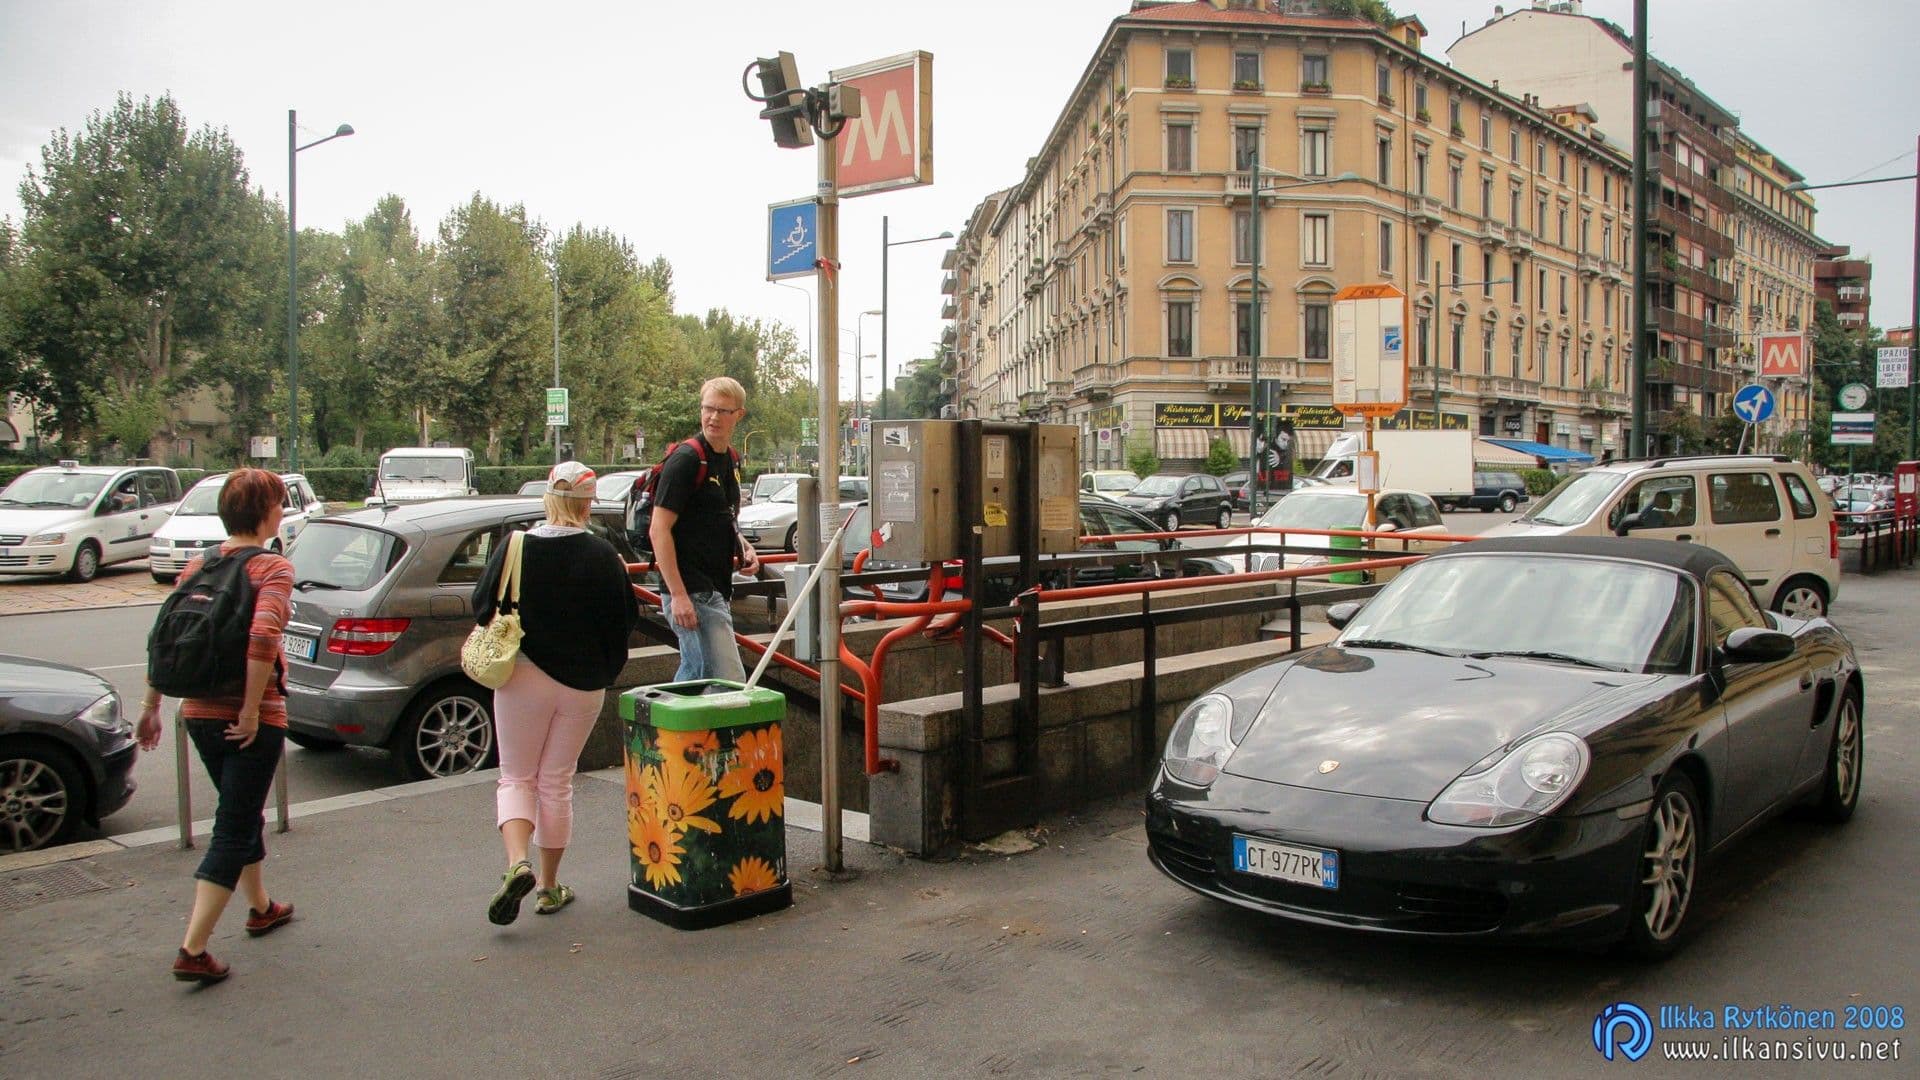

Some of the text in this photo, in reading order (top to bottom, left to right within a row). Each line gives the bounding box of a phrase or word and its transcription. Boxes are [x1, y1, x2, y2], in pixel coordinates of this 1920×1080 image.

[842, 89, 912, 166] M
[1764, 343, 1799, 368] M
[1878, 348, 1908, 358] SPAZIO
[1878, 363, 1907, 372] LIBERO
[1164, 404, 1206, 413] Ristorante
[1248, 846, 1267, 869] CT
[1271, 850, 1321, 879] 977PK
